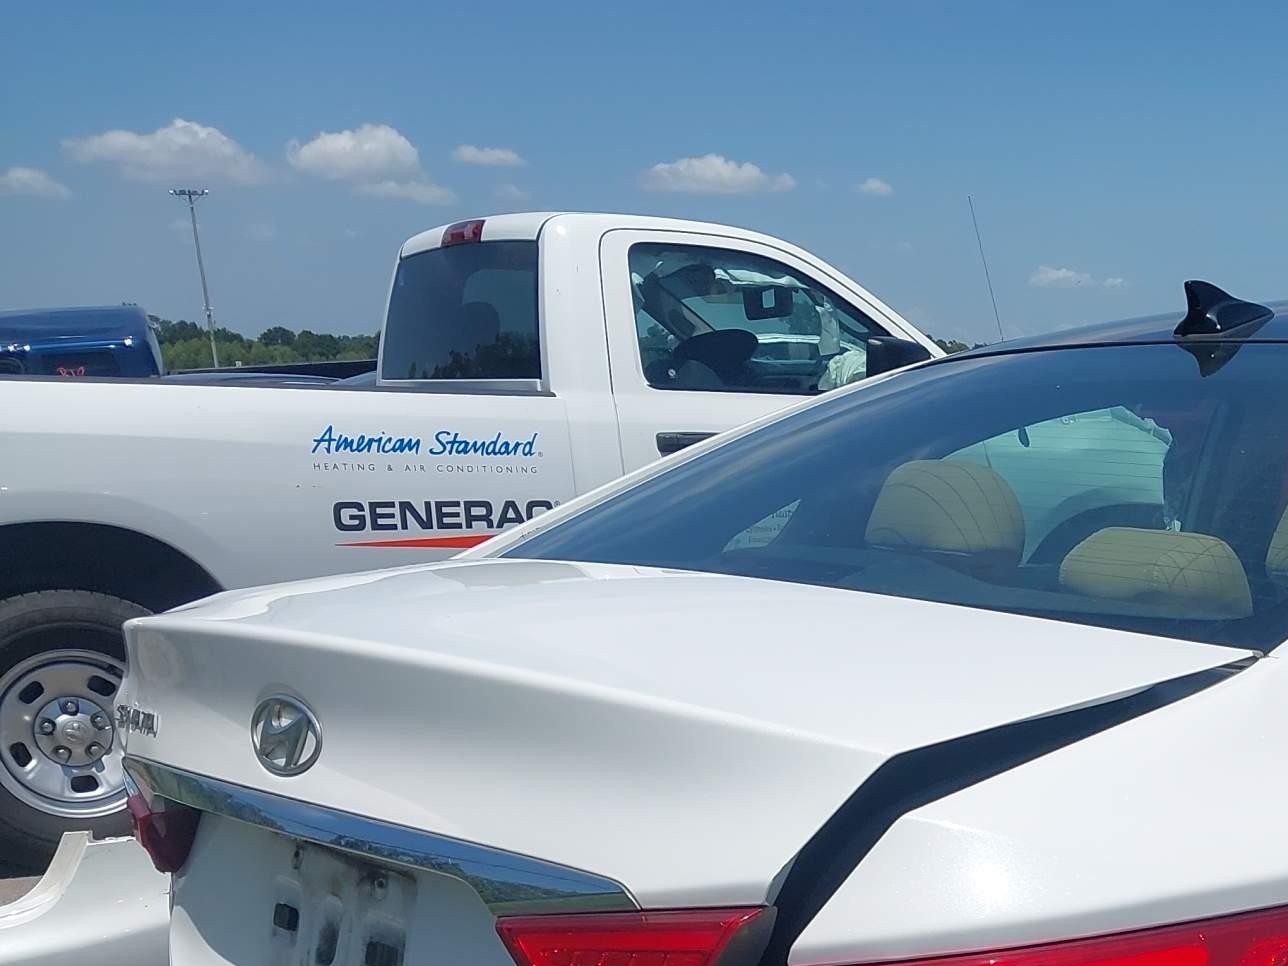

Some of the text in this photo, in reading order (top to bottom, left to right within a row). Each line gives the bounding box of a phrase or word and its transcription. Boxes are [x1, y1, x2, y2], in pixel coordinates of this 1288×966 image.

[311, 425, 538, 456] American Standard
[313, 462, 538, 474] HEATING & AIR CONDITIONING
